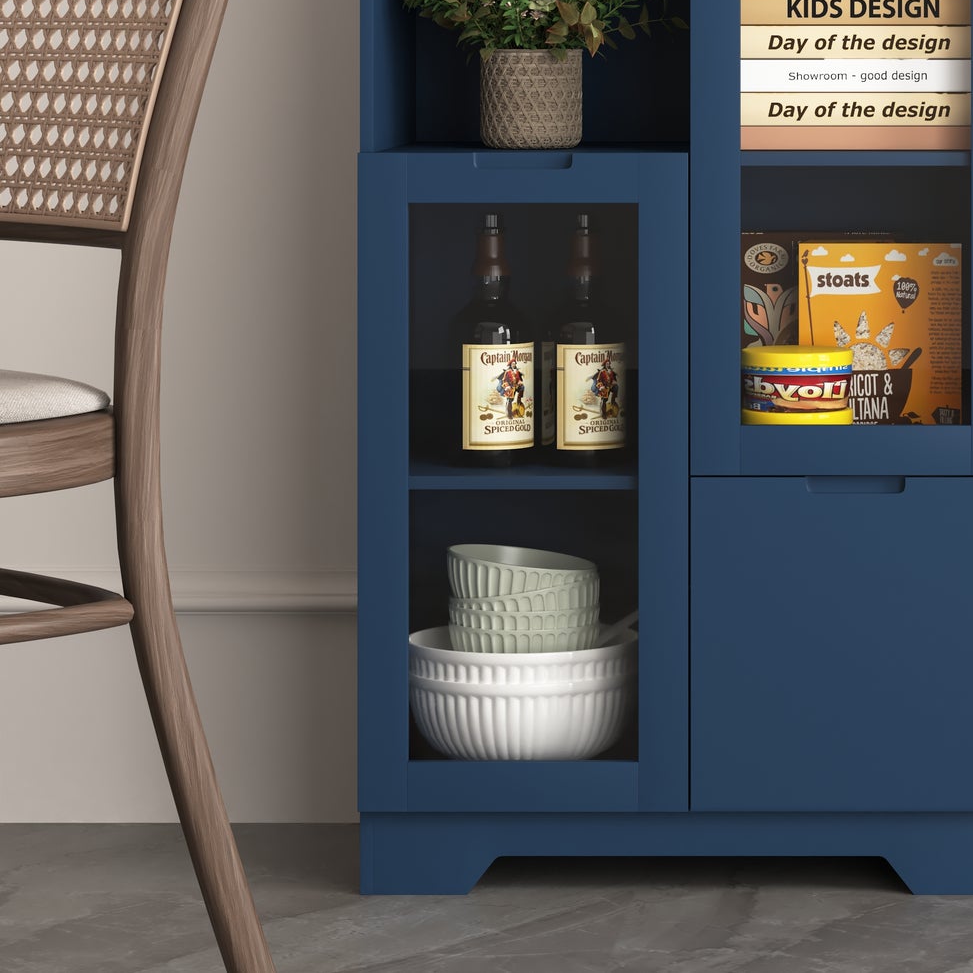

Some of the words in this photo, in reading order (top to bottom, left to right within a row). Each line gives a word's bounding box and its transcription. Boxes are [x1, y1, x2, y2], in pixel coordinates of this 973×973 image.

[768, 35, 808, 53] Day
[814, 34, 837, 49] of
[842, 34, 875, 49] the
[882, 34, 951, 53] design
[788, 71, 848, 81] Showroom
[860, 71, 888, 82] good
[891, 70, 928, 82] design
[768, 102, 808, 120] Day
[814, 101, 837, 116] of
[842, 101, 875, 116] the
[882, 101, 951, 120] design
[747, 245, 768, 259] DOVES
[817, 272, 870, 288] stoats
[897, 282, 917, 292] 100%
[896, 291, 917, 300] Natural
[480, 351, 511, 366] Captain
[575, 351, 605, 366] Captain
[884, 373, 893, 395] &
[484, 425, 514, 435] SPICED
[515, 424, 531, 432] GOLD
[578, 425, 609, 435] SPICED
